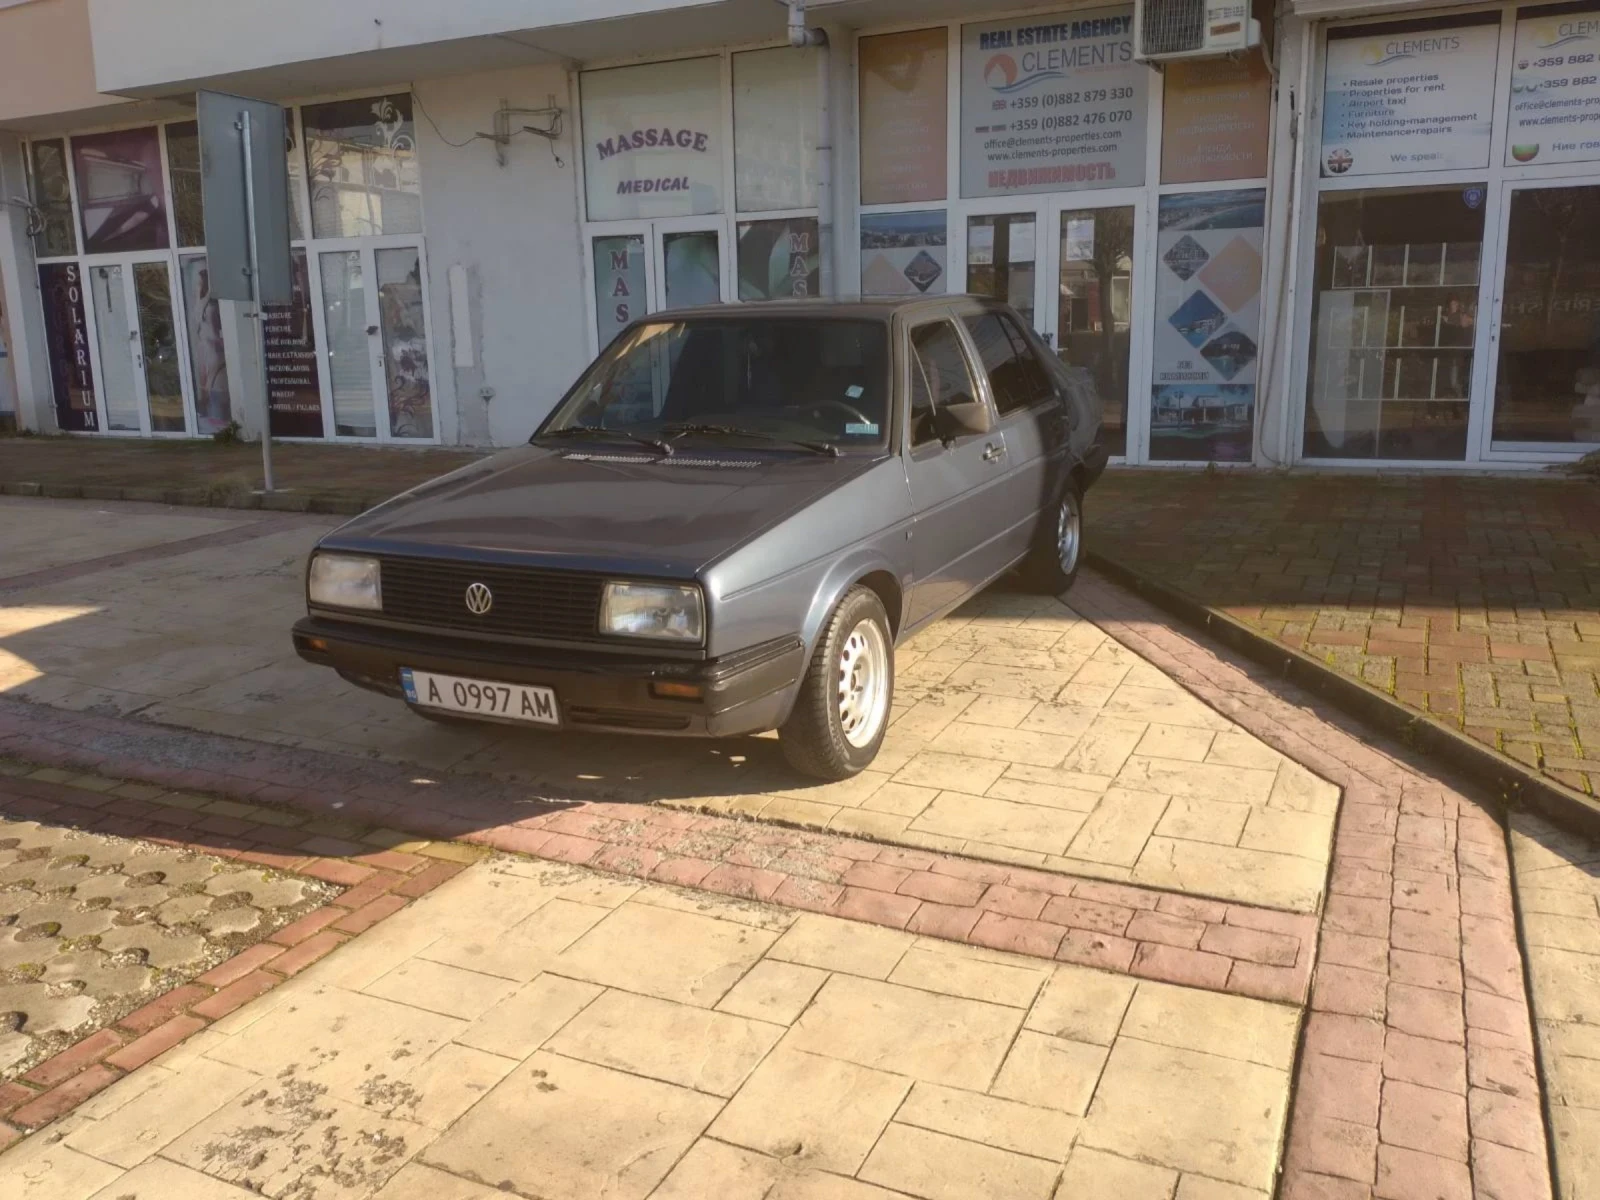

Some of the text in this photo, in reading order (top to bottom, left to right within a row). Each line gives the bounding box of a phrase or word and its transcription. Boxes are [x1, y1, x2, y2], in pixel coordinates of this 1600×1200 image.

[980, 15, 1132, 50] REAL ESTATE AGENCY
[1558, 20, 1600, 37] CLEM
[1386, 36, 1460, 55] CLEMENTS
[1022, 41, 1133, 73] CLEMENTS
[1533, 53, 1595, 68] +359 882
[1349, 73, 1439, 87] Resale properties
[1539, 75, 1598, 89] +359 882
[1009, 86, 1134, 109] +359 (0)882 879 330
[1349, 83, 1446, 98] Properties for rent
[1348, 96, 1406, 108] Airport taxi
[1009, 109, 1133, 132] +359 (0)882 476 070
[597, 128, 708, 160] MASSAGE
[984, 129, 1122, 149] office@clements-properties.com
[987, 143, 1118, 161] www.clements-properties.com
[1390, 153, 1407, 162] We
[616, 176, 690, 195] MEDICAL
[66, 265, 95, 427] SOLARIUM
[428, 677, 443, 704] A
[453, 681, 511, 713] 0997
[521, 689, 554, 719] AM
